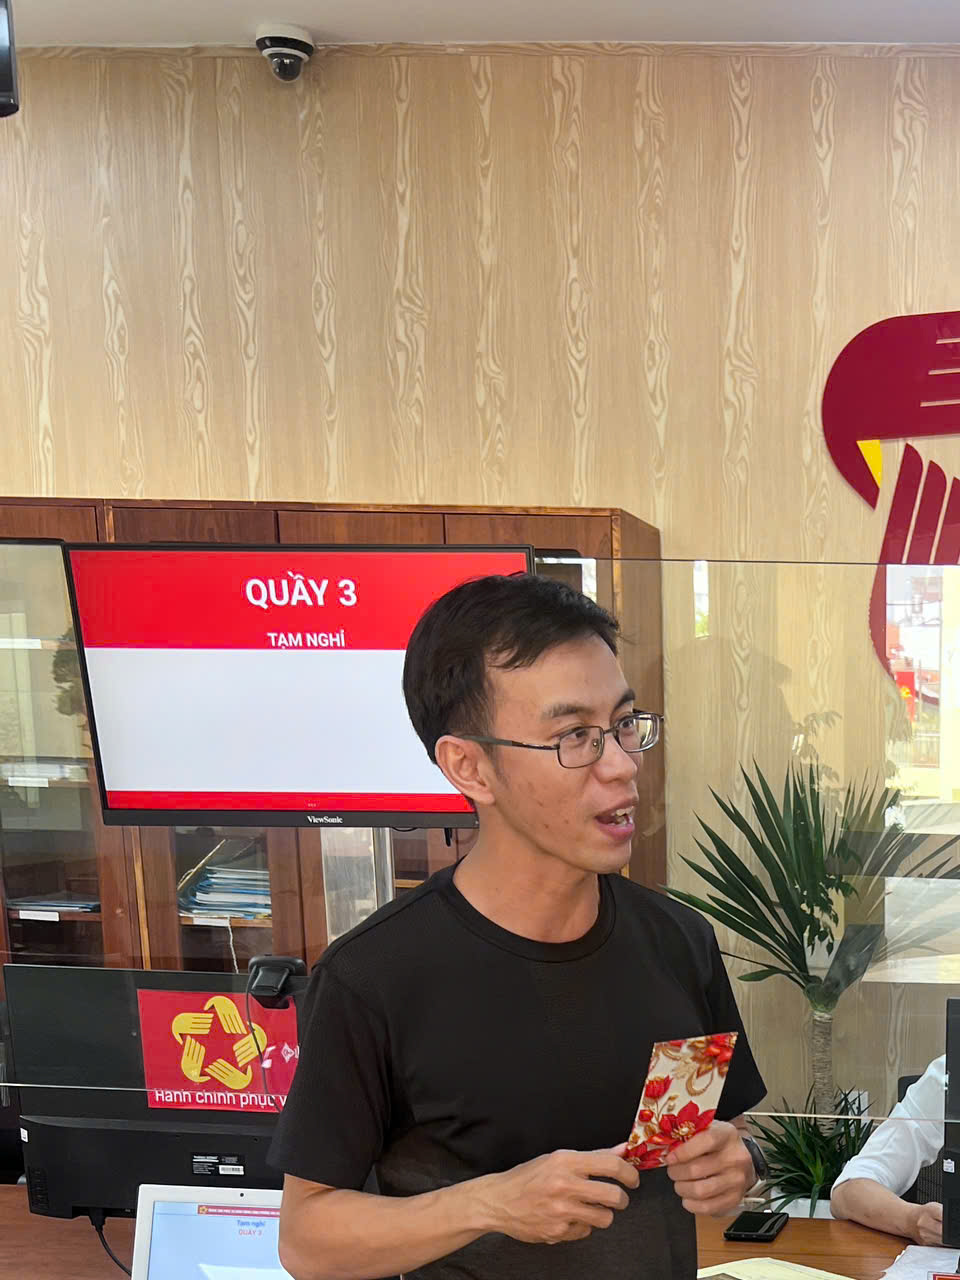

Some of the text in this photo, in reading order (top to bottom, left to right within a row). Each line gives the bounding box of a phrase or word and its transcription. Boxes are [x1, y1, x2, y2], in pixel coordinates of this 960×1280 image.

[245, 571, 358, 610] QUẦY 3
[267, 629, 345, 649] TẠM NGHỈ
[307, 815, 343, 824] ViewSonic
